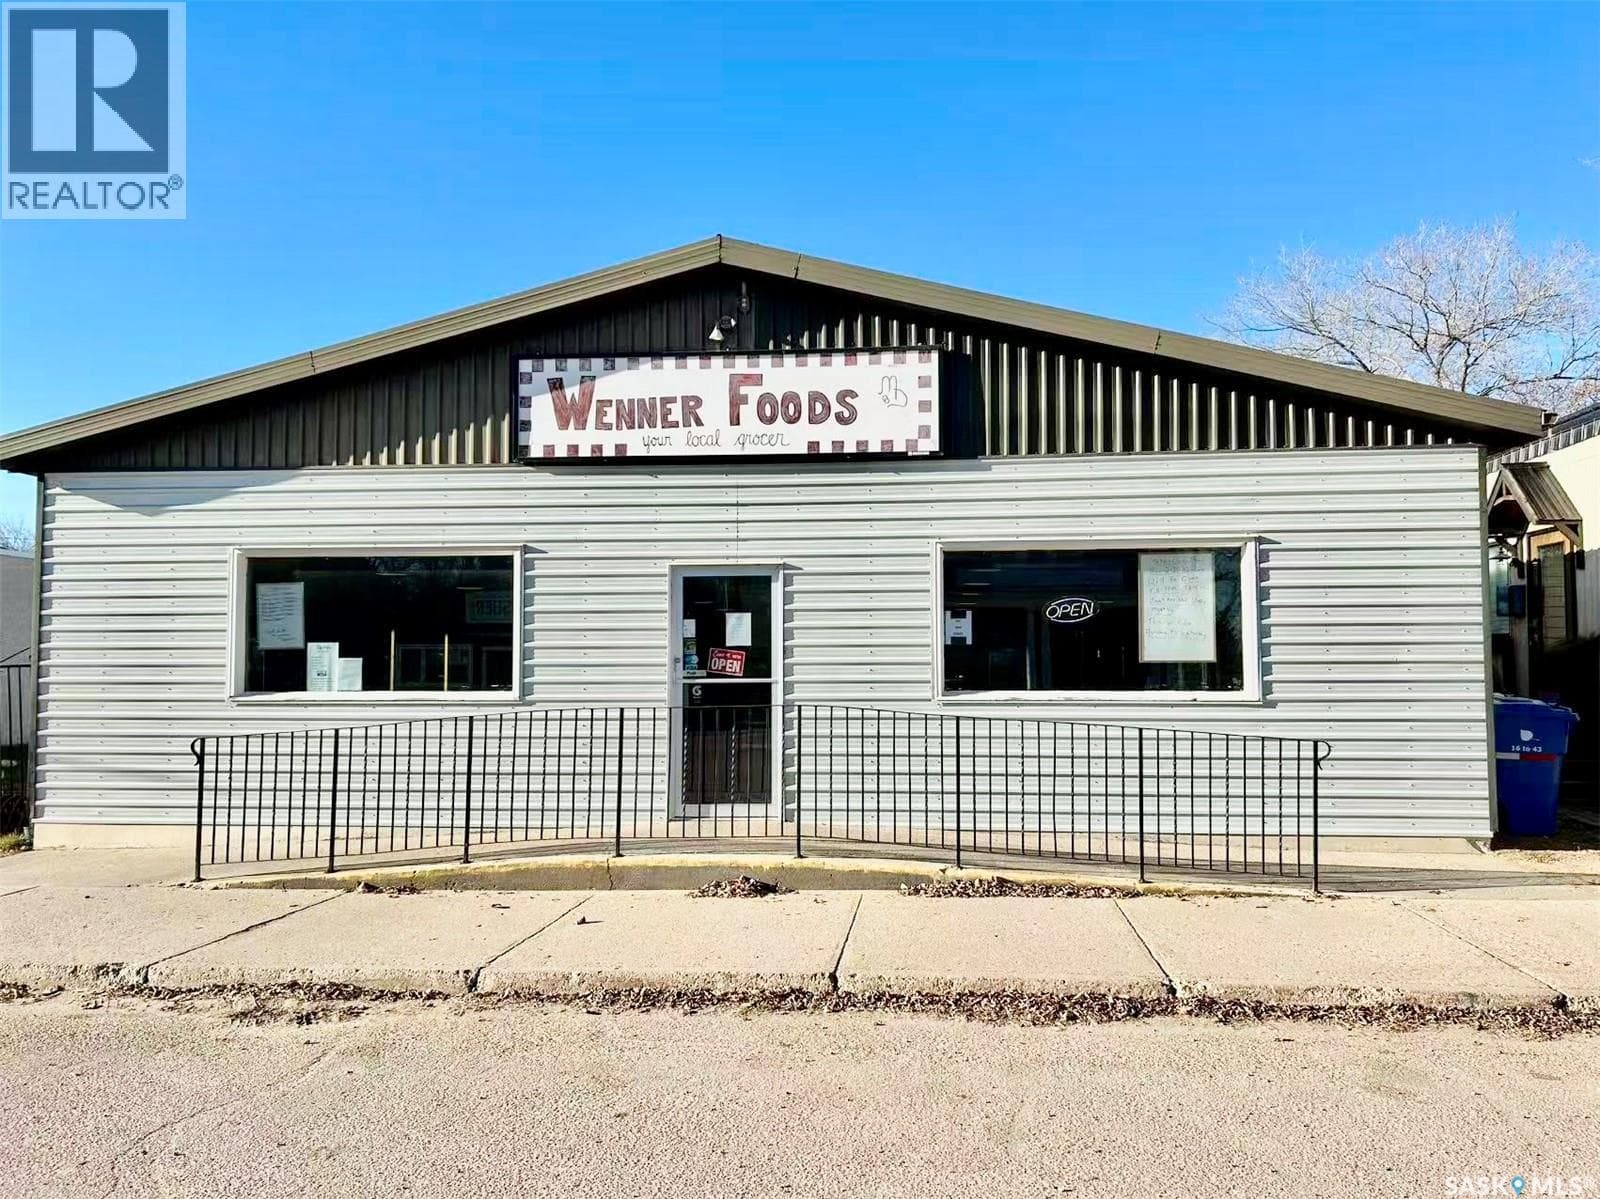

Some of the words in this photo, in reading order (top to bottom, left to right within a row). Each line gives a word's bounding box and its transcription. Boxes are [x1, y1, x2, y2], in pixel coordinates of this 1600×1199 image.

[729, 373, 859, 427] FOODS
[642, 434, 673, 454] your
[685, 428, 721, 447] local
[734, 432, 790, 451] grocer
[1046, 602, 1094, 619] OPEN
[711, 658, 741, 672] OPEN
